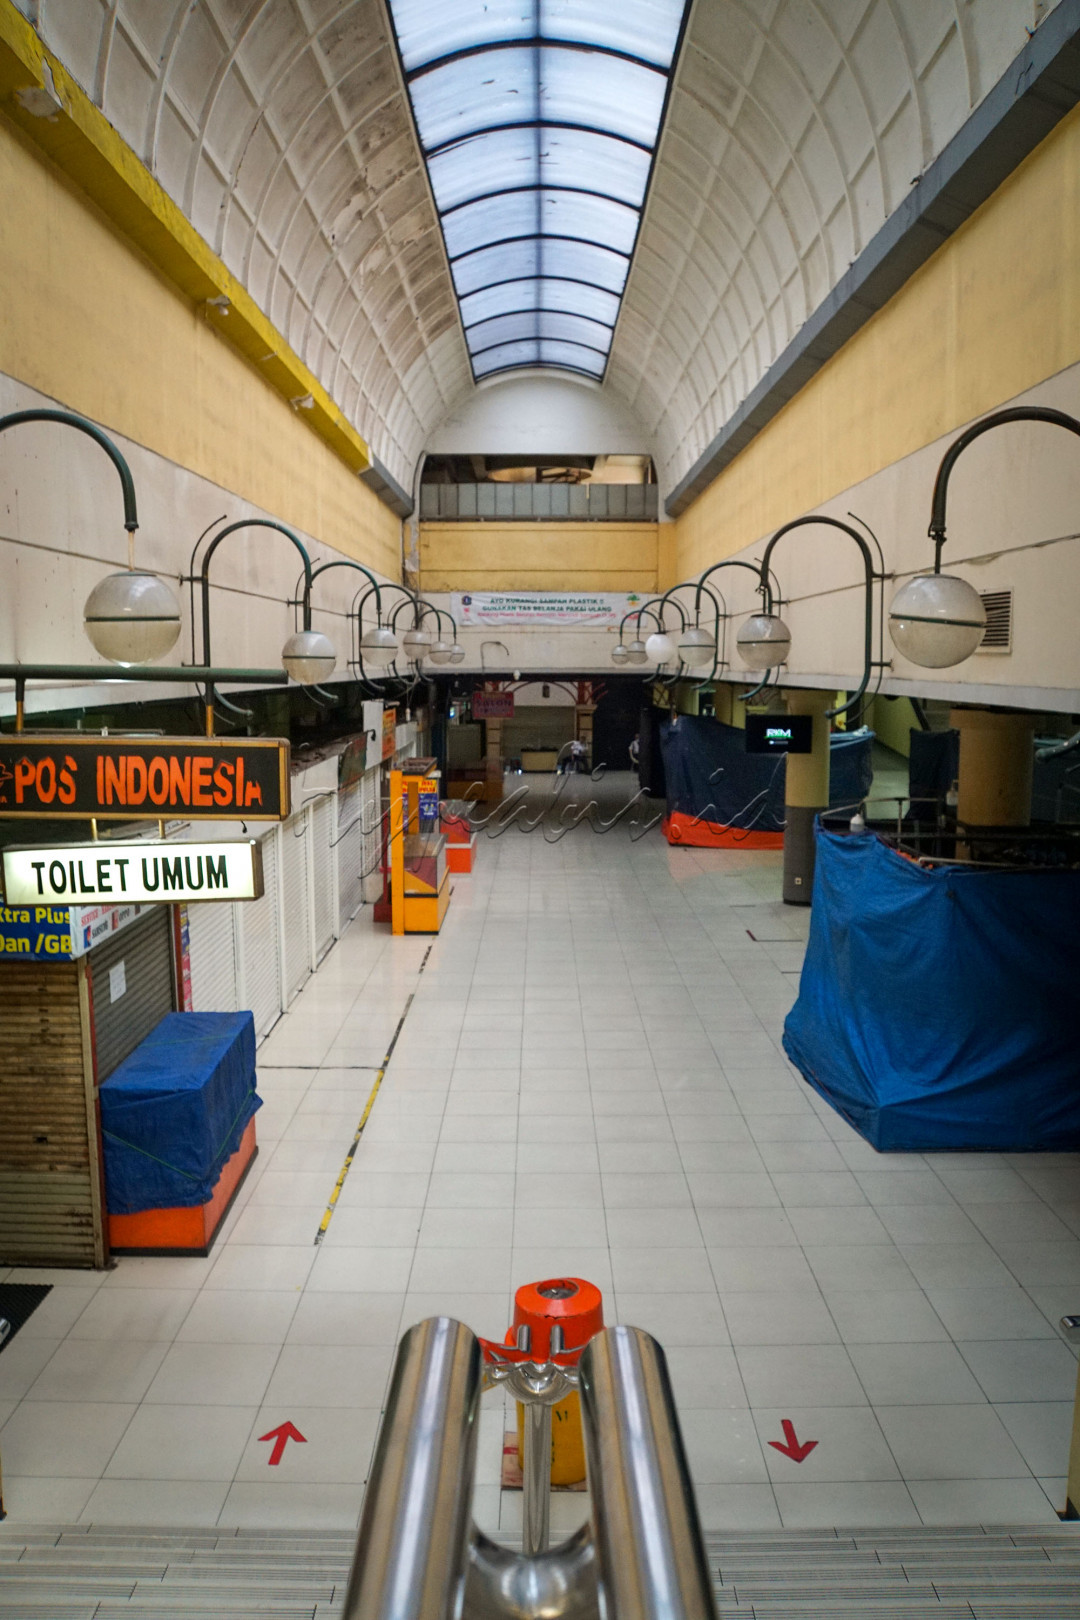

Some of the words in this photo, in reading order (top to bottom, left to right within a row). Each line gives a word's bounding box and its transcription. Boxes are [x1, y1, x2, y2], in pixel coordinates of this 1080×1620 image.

[14, 755, 77, 806] POS
[31, 858, 130, 895] TOILET
[141, 855, 228, 892] UMUM
[35, 907, 70, 924] Plus
[35, 933, 72, 954] /GB
